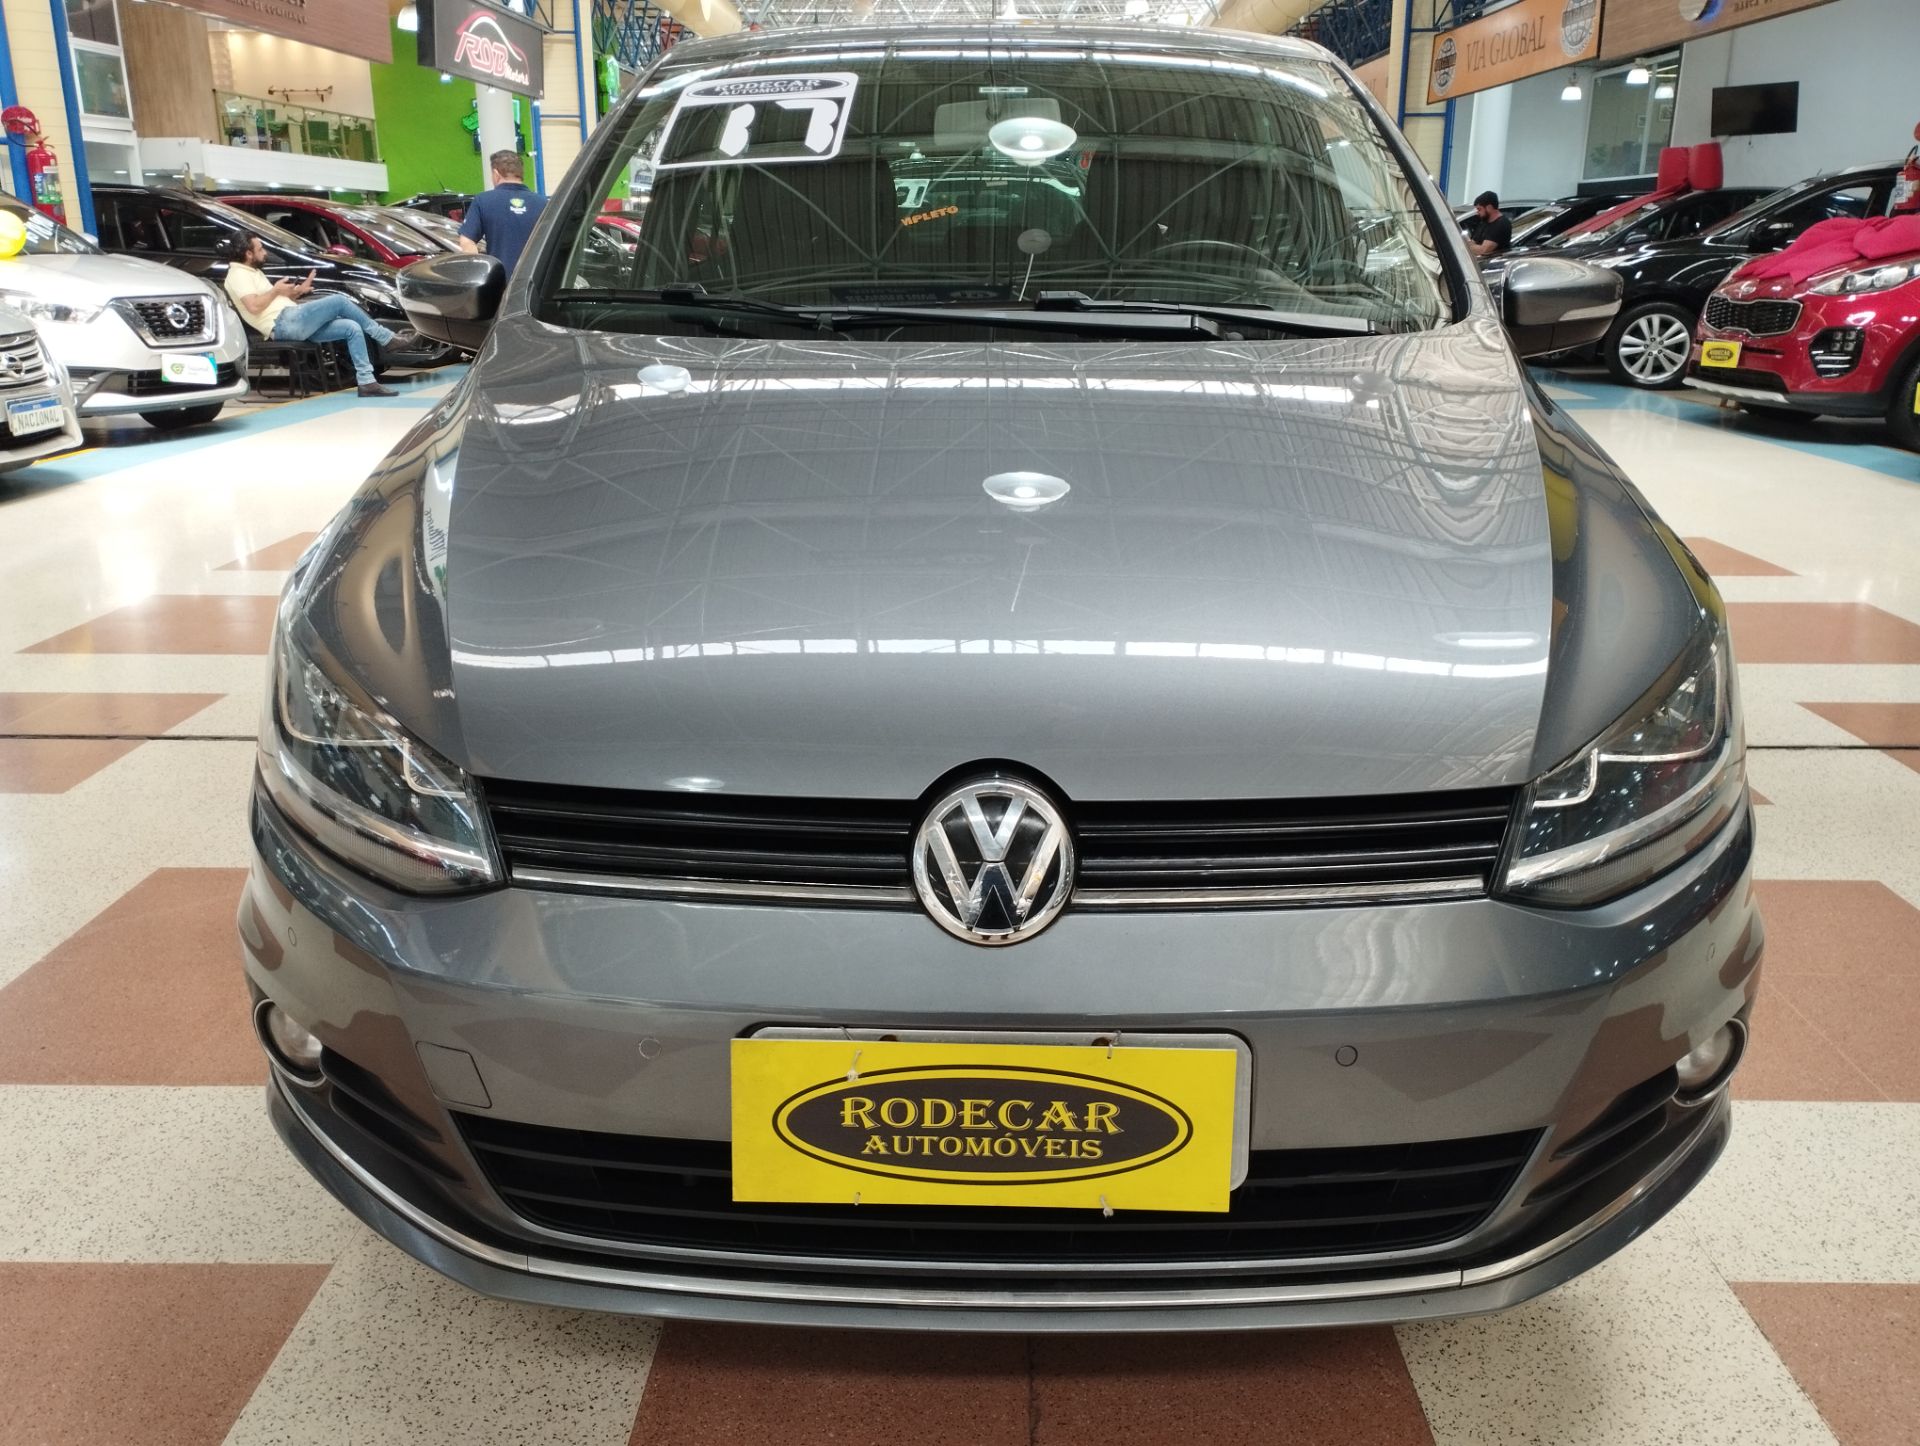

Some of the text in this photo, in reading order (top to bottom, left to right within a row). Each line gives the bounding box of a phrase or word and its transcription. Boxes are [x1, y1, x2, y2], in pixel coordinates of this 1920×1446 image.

[1466, 40, 1486, 72] VIA
[1490, 16, 1546, 66] GLOBAL
[714, 79, 821, 92] RODECAR
[901, 206, 959, 226] MPLETO
[17, 408, 60, 431] NACIONAL
[840, 1096, 1125, 1134] RODECAR
[860, 1133, 1104, 1159] AUTOMÓVEIS
